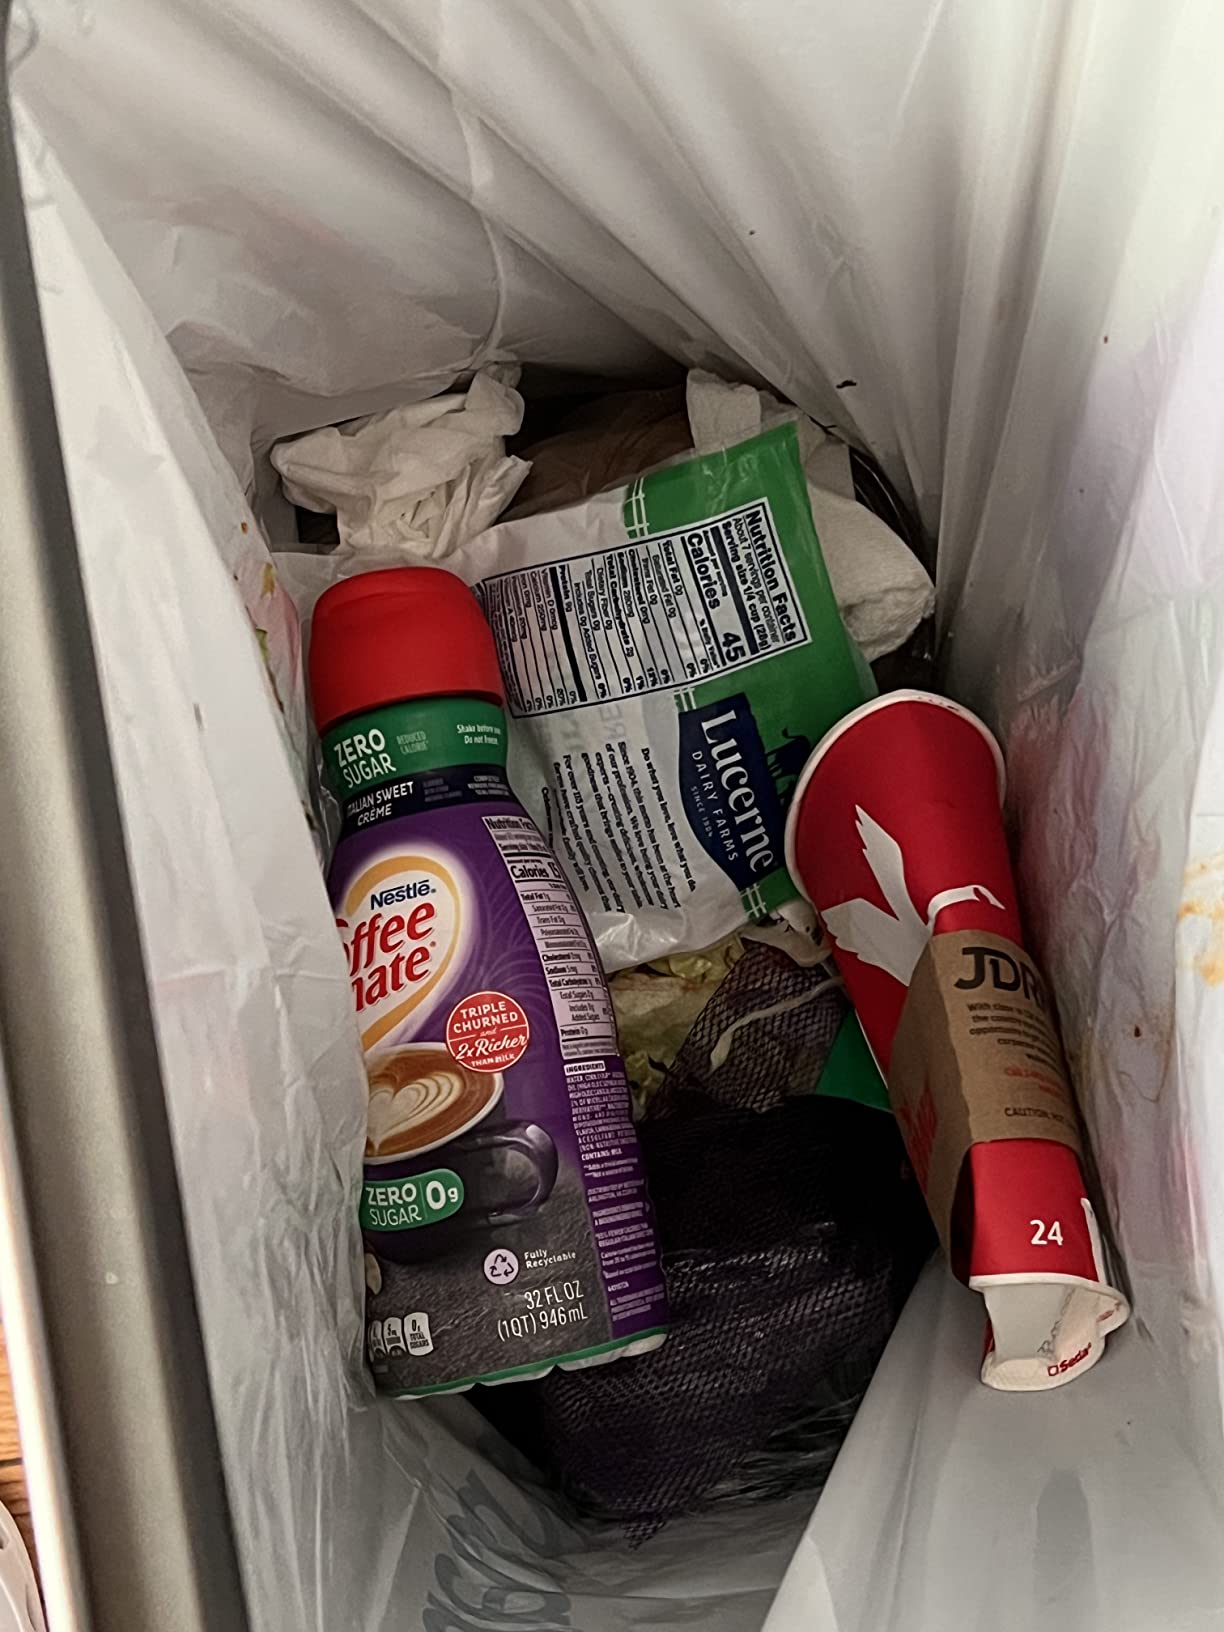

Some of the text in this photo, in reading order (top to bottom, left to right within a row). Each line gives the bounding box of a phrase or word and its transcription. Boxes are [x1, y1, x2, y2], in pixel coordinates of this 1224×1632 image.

[732, 517, 748, 544] About
[662, 539, 677, 565] Total
[668, 566, 680, 583] Fat
[721, 520, 771, 650] Serving size 1/4 cup (28g)
[745, 510, 796, 641] Nutrition Facts
[673, 584, 683, 595] 0g
[687, 533, 745, 662] Calories 45
[456, 724, 476, 734] Shake
[464, 735, 473, 744] Do
[334, 729, 386, 768] ZERO
[617, 741, 629, 765] Since
[641, 747, 650, 761] Do
[343, 753, 397, 789] SUGAR
[562, 754, 572, 770] For
[646, 761, 659, 784] what
[376, 781, 414, 804] SWEET
[605, 743, 615, 752] of
[629, 815, 639, 830] We
[651, 784, 664, 802] you
[702, 710, 774, 873] Lucerne
[690, 785, 704, 812] SINCE
[692, 750, 737, 860] DAIRY FARMS
[357, 803, 392, 826] CRÈME
[674, 841, 686, 862] what
[510, 865, 550, 878] Calories
[336, 902, 435, 976] ffee
[460, 1001, 507, 1019] TRIPLE
[453, 1012, 519, 1034] CHURNED
[475, 1035, 528, 1056] Richer
[366, 1180, 458, 1210] ZERO 0g
[369, 1206, 422, 1226] SUGAR
[1030, 1220, 1064, 1246] 24
[524, 1249, 548, 1260] Fully
[526, 1251, 576, 1270] Recyclable
[524, 1281, 584, 1310] 32 FL OZ
[497, 1314, 537, 1342] (1QT)
